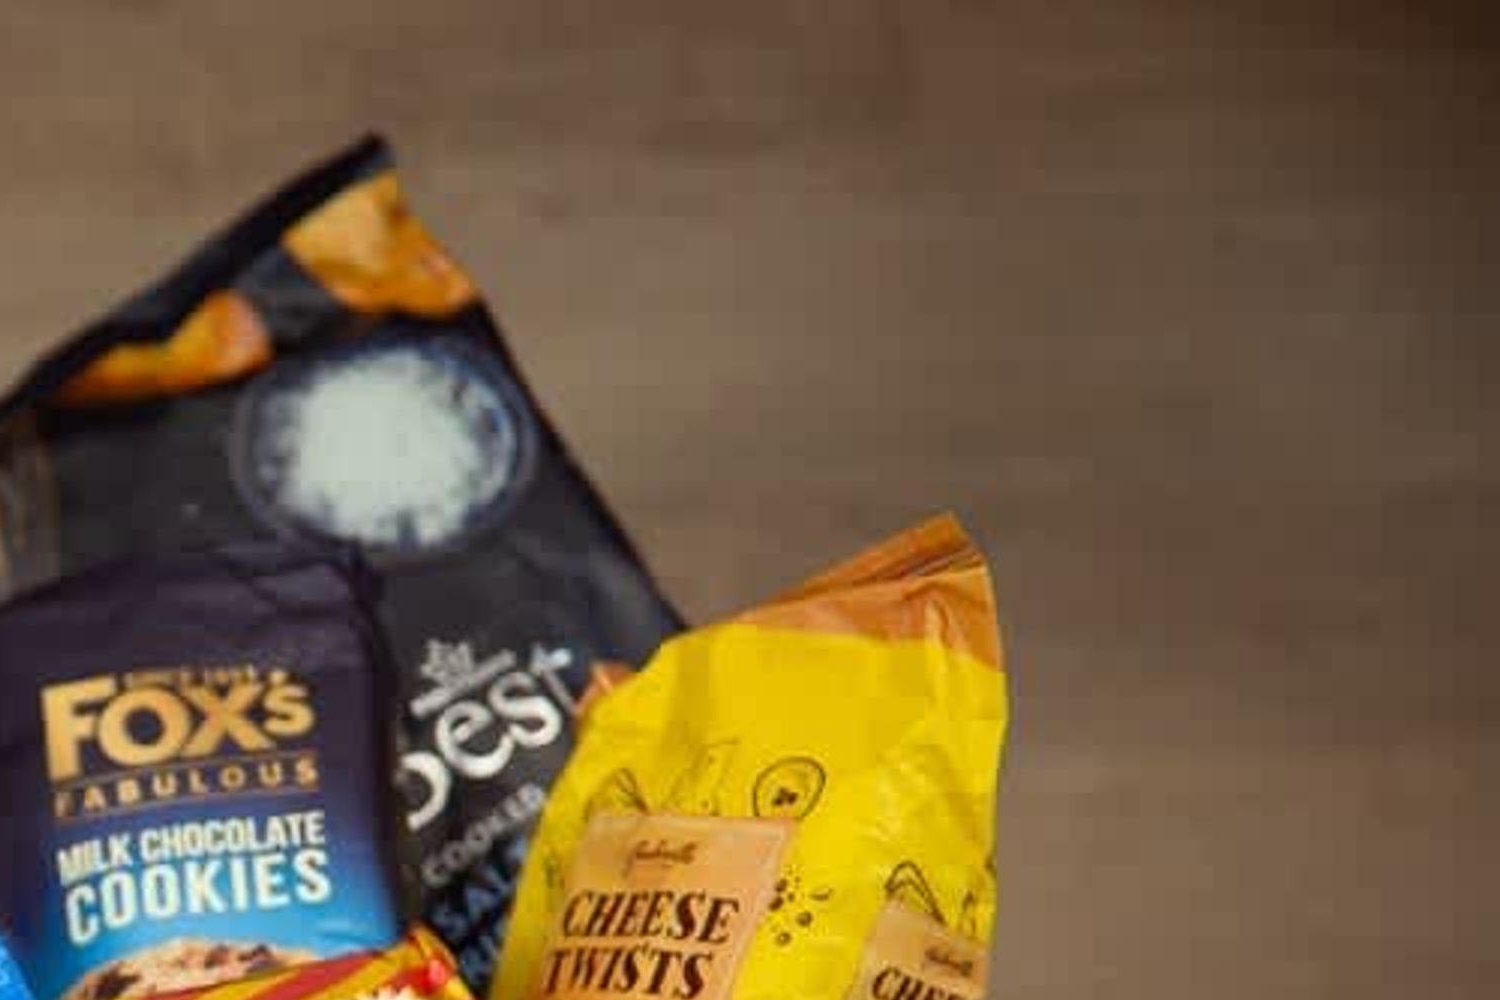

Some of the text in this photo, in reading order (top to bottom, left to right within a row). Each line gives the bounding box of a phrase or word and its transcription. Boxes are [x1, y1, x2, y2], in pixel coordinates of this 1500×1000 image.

[53, 755, 319, 818] FABULOUS
[57, 810, 326, 886] MILK CHOCOLATE
[64, 848, 332, 946] COOKIES
[562, 888, 740, 944] CHEESE
[543, 942, 713, 1000] TWISTS
